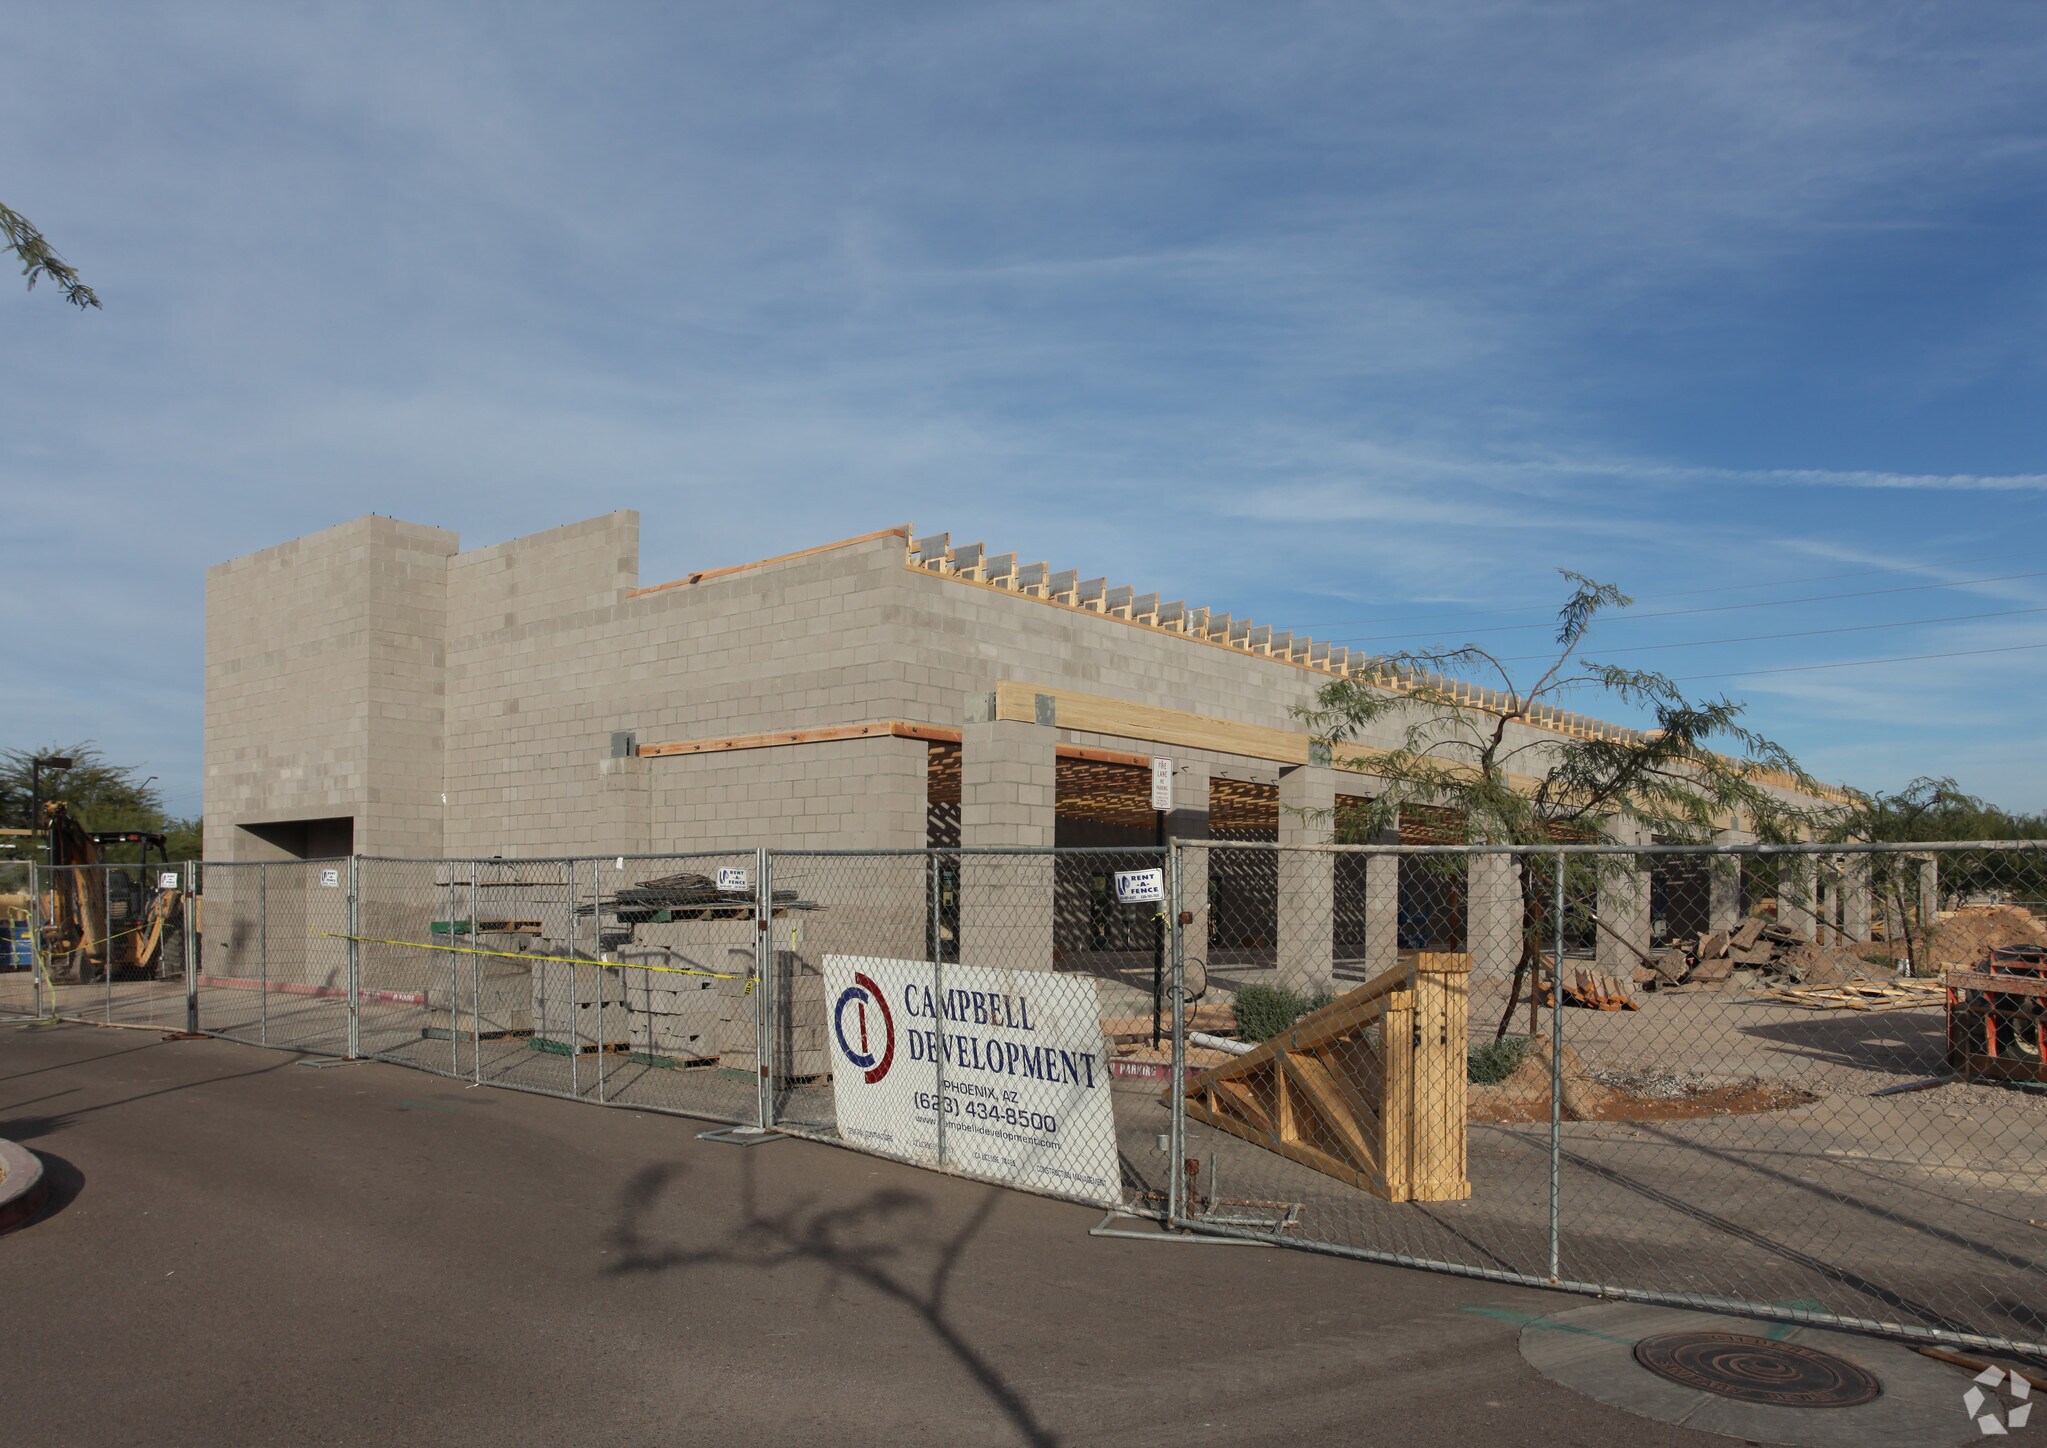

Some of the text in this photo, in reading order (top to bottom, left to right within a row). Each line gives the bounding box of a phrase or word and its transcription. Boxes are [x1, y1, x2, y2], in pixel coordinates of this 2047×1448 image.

[904, 984, 1035, 1031] CAMPBELL
[907, 1029, 1096, 1089] DEVELOPMENT
[1120, 1063, 1156, 1077] PARKING
[944, 1080, 1019, 1104] PHOENIX, AZ
[915, 1115, 1061, 1150] www.ampbell-development.com
[966, 1101, 1056, 1133] 434-8500
